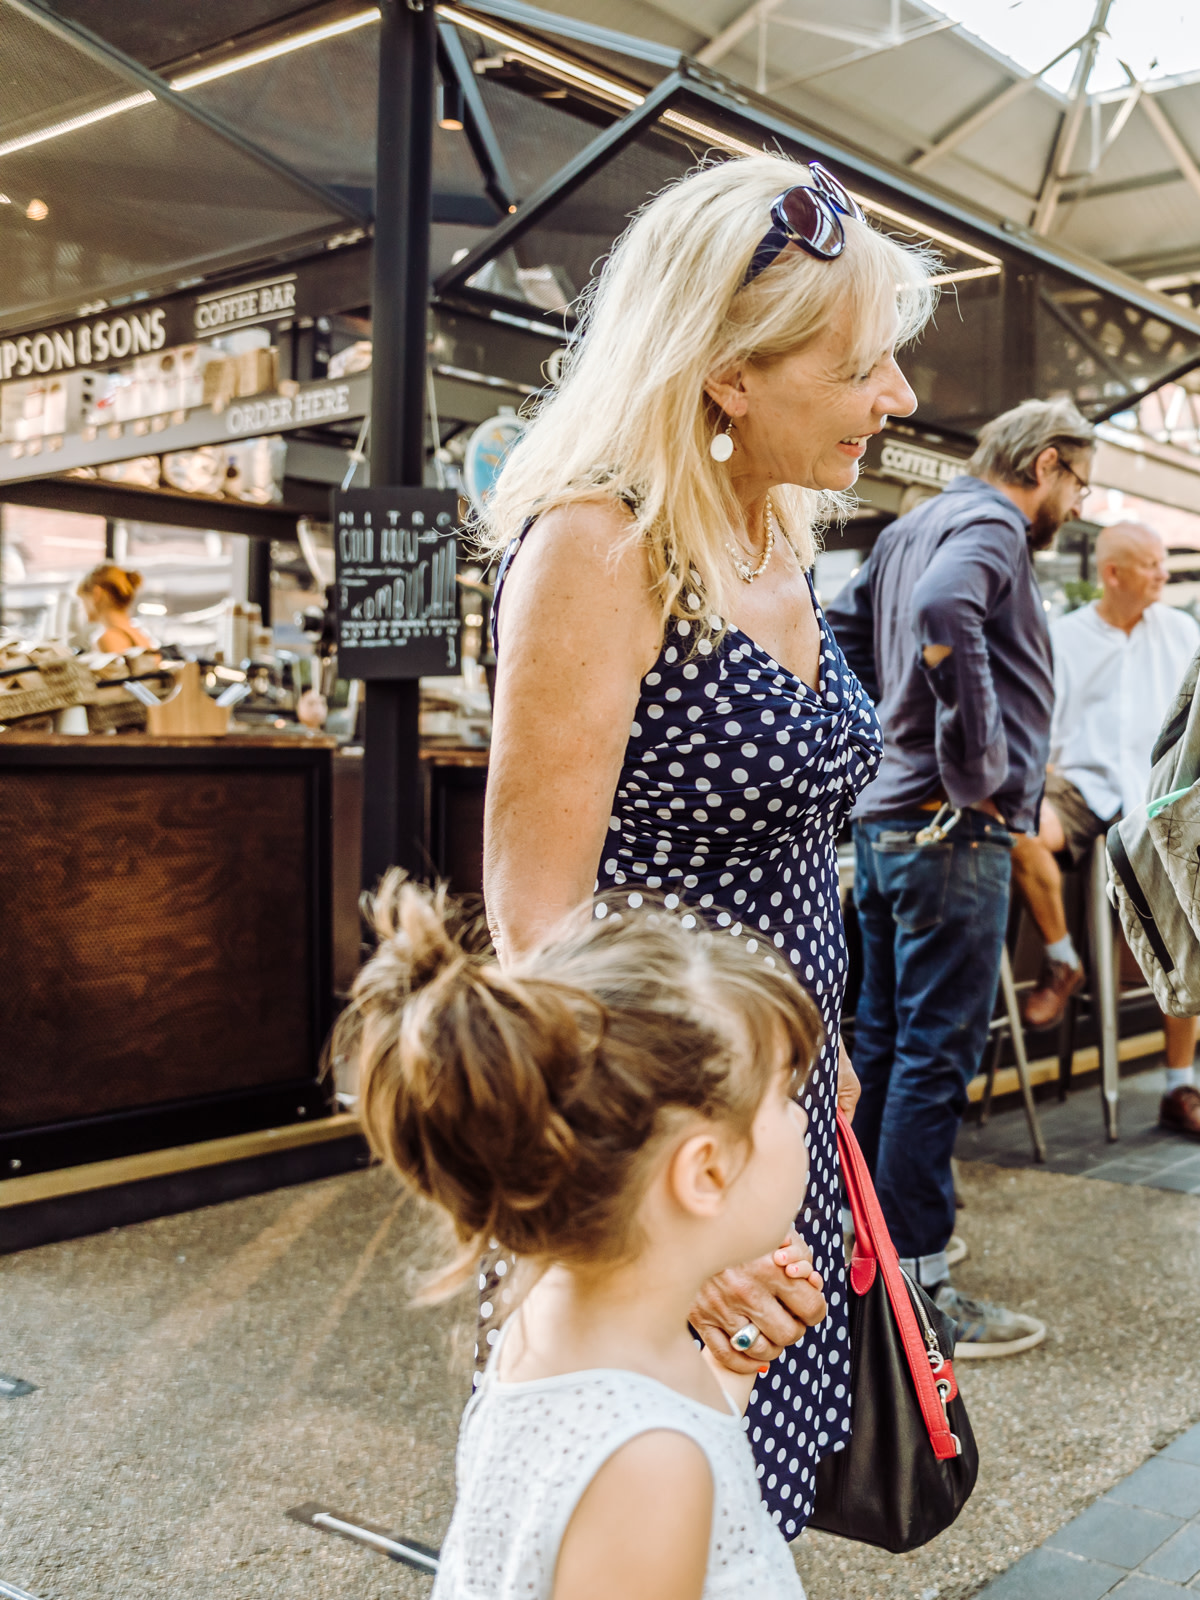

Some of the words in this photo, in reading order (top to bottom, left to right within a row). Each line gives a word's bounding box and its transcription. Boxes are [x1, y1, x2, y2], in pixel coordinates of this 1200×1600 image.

[194, 291, 258, 329] COFFEE
[259, 282, 296, 314] BAR
[226, 397, 293, 434] ORDER
[295, 384, 349, 421] HERE
